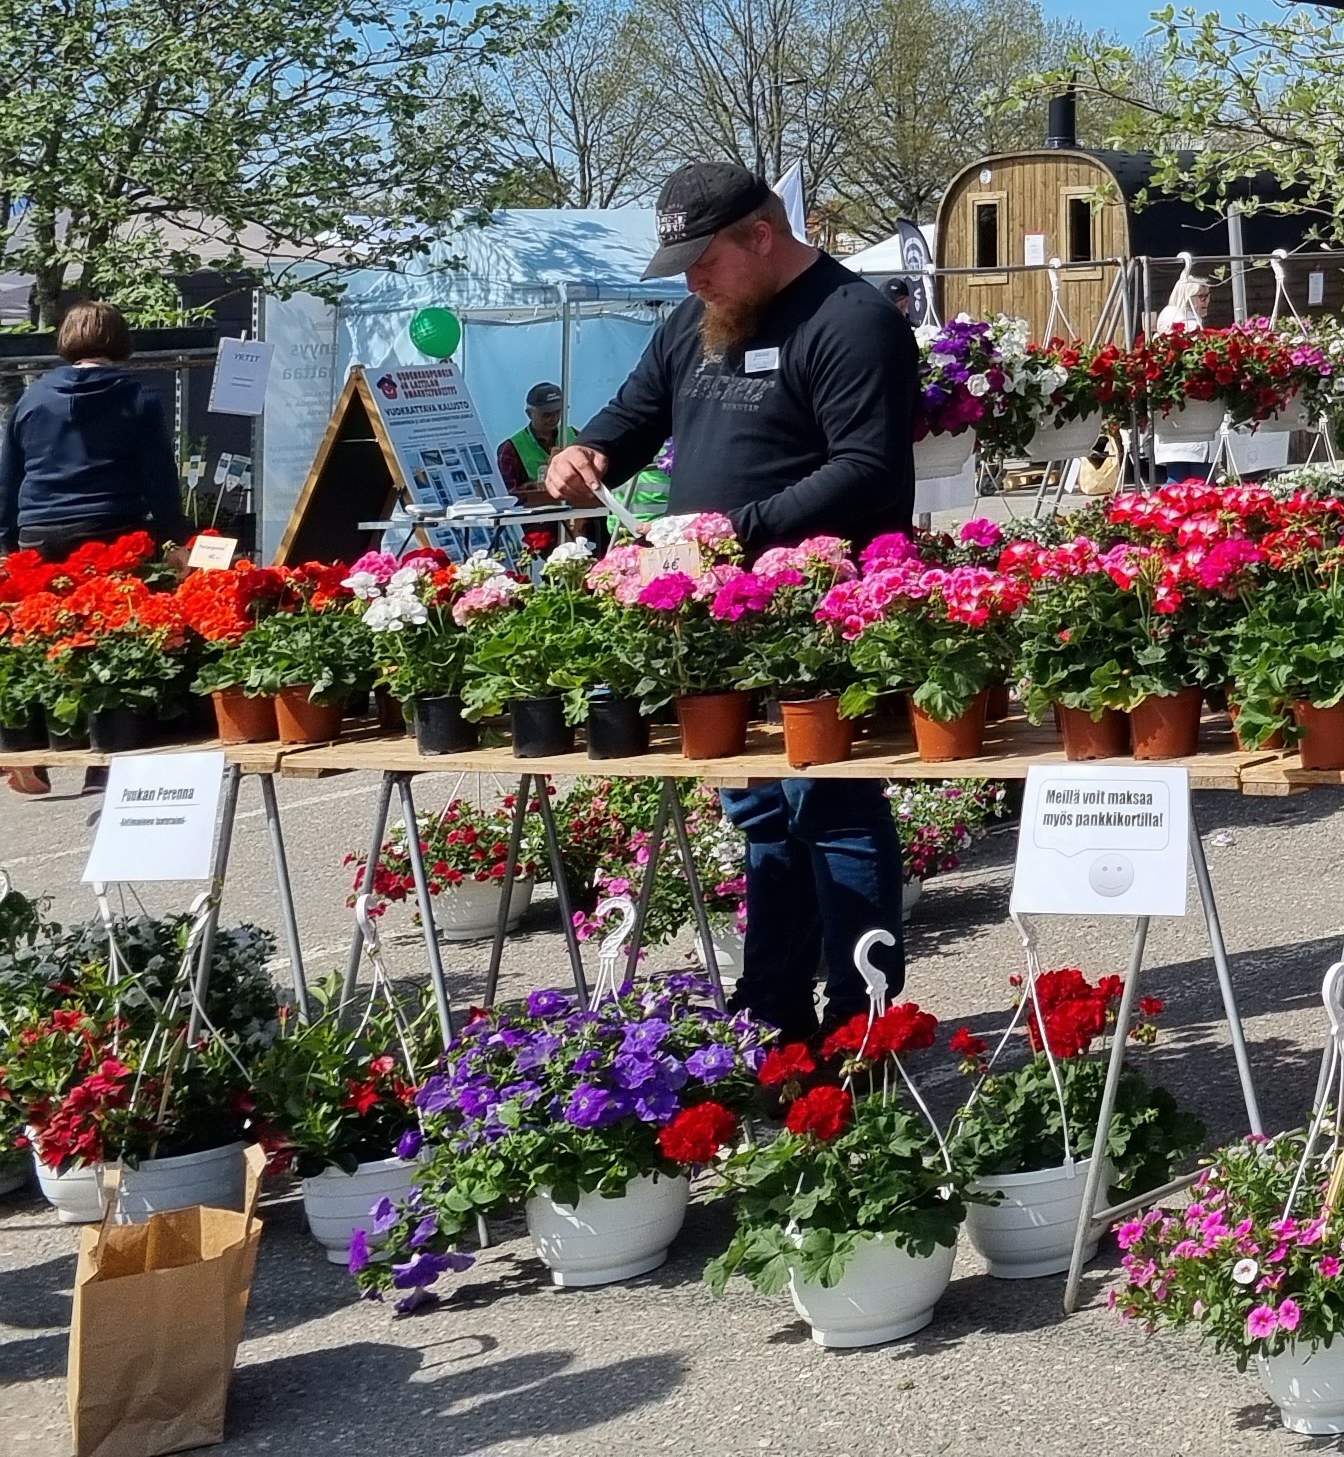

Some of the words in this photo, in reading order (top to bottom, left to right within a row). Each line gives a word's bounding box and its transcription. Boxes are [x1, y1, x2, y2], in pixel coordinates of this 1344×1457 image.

[384, 404, 437, 416] VUOKRATTAVA
[438, 401, 470, 412] KALUSTO
[662, 557, 680, 571] 4€
[121, 788, 156, 802] Puukan
[156, 787, 195, 801] Perenna
[1045, 789, 1080, 805] Meillä
[1082, 790, 1105, 805] voit
[1107, 790, 1153, 805] maksaa
[1042, 811, 1073, 828] myös
[1075, 812, 1164, 828] pankkikortilla!
